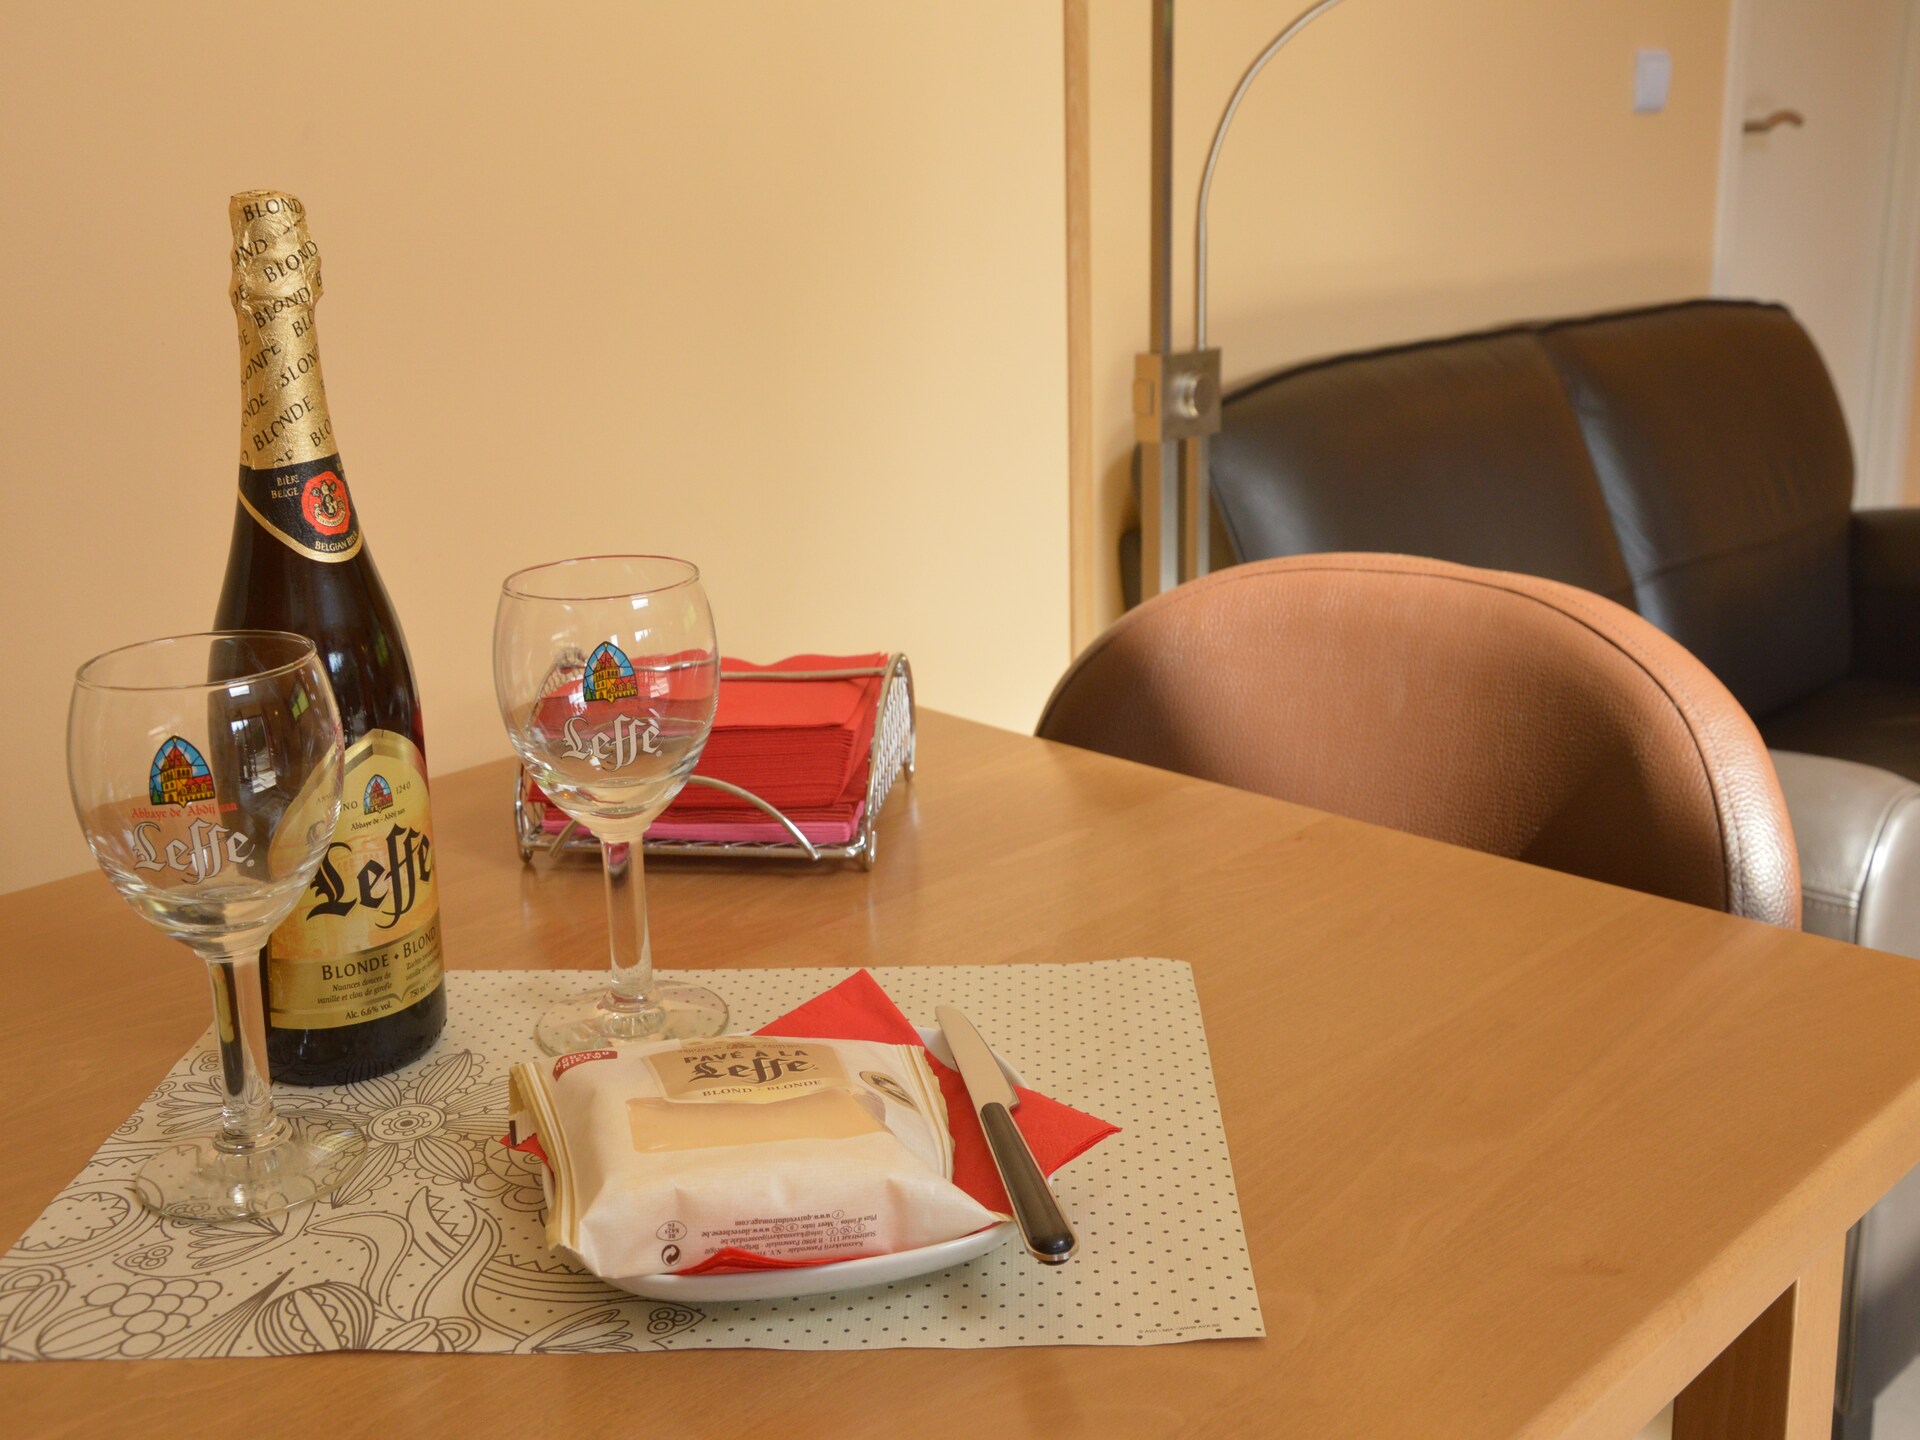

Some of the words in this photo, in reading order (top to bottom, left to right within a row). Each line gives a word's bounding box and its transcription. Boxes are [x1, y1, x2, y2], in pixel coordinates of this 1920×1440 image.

[253, 395, 314, 451] BLONDE
[271, 487, 299, 499] BELGE
[315, 540, 347, 551] BELGIAN
[561, 712, 664, 772] Leffe
[132, 808, 167, 821] Abbaye
[169, 806, 181, 817] de
[187, 806, 216, 819] Abdij
[133, 817, 256, 885] Leffe
[306, 823, 432, 929] Leffe
[322, 953, 390, 981] BLONDE
[333, 982, 360, 993] Nuances
[361, 975, 383, 987] douces
[383, 971, 392, 980] de
[317, 994, 340, 1005] vanille
[341, 993, 348, 1002] et
[349, 990, 363, 1000] clou
[364, 987, 373, 996] de
[688, 1056, 816, 1085] Leffe
[702, 1088, 753, 1097] BLOND
[767, 1079, 823, 1091] BLONDE
